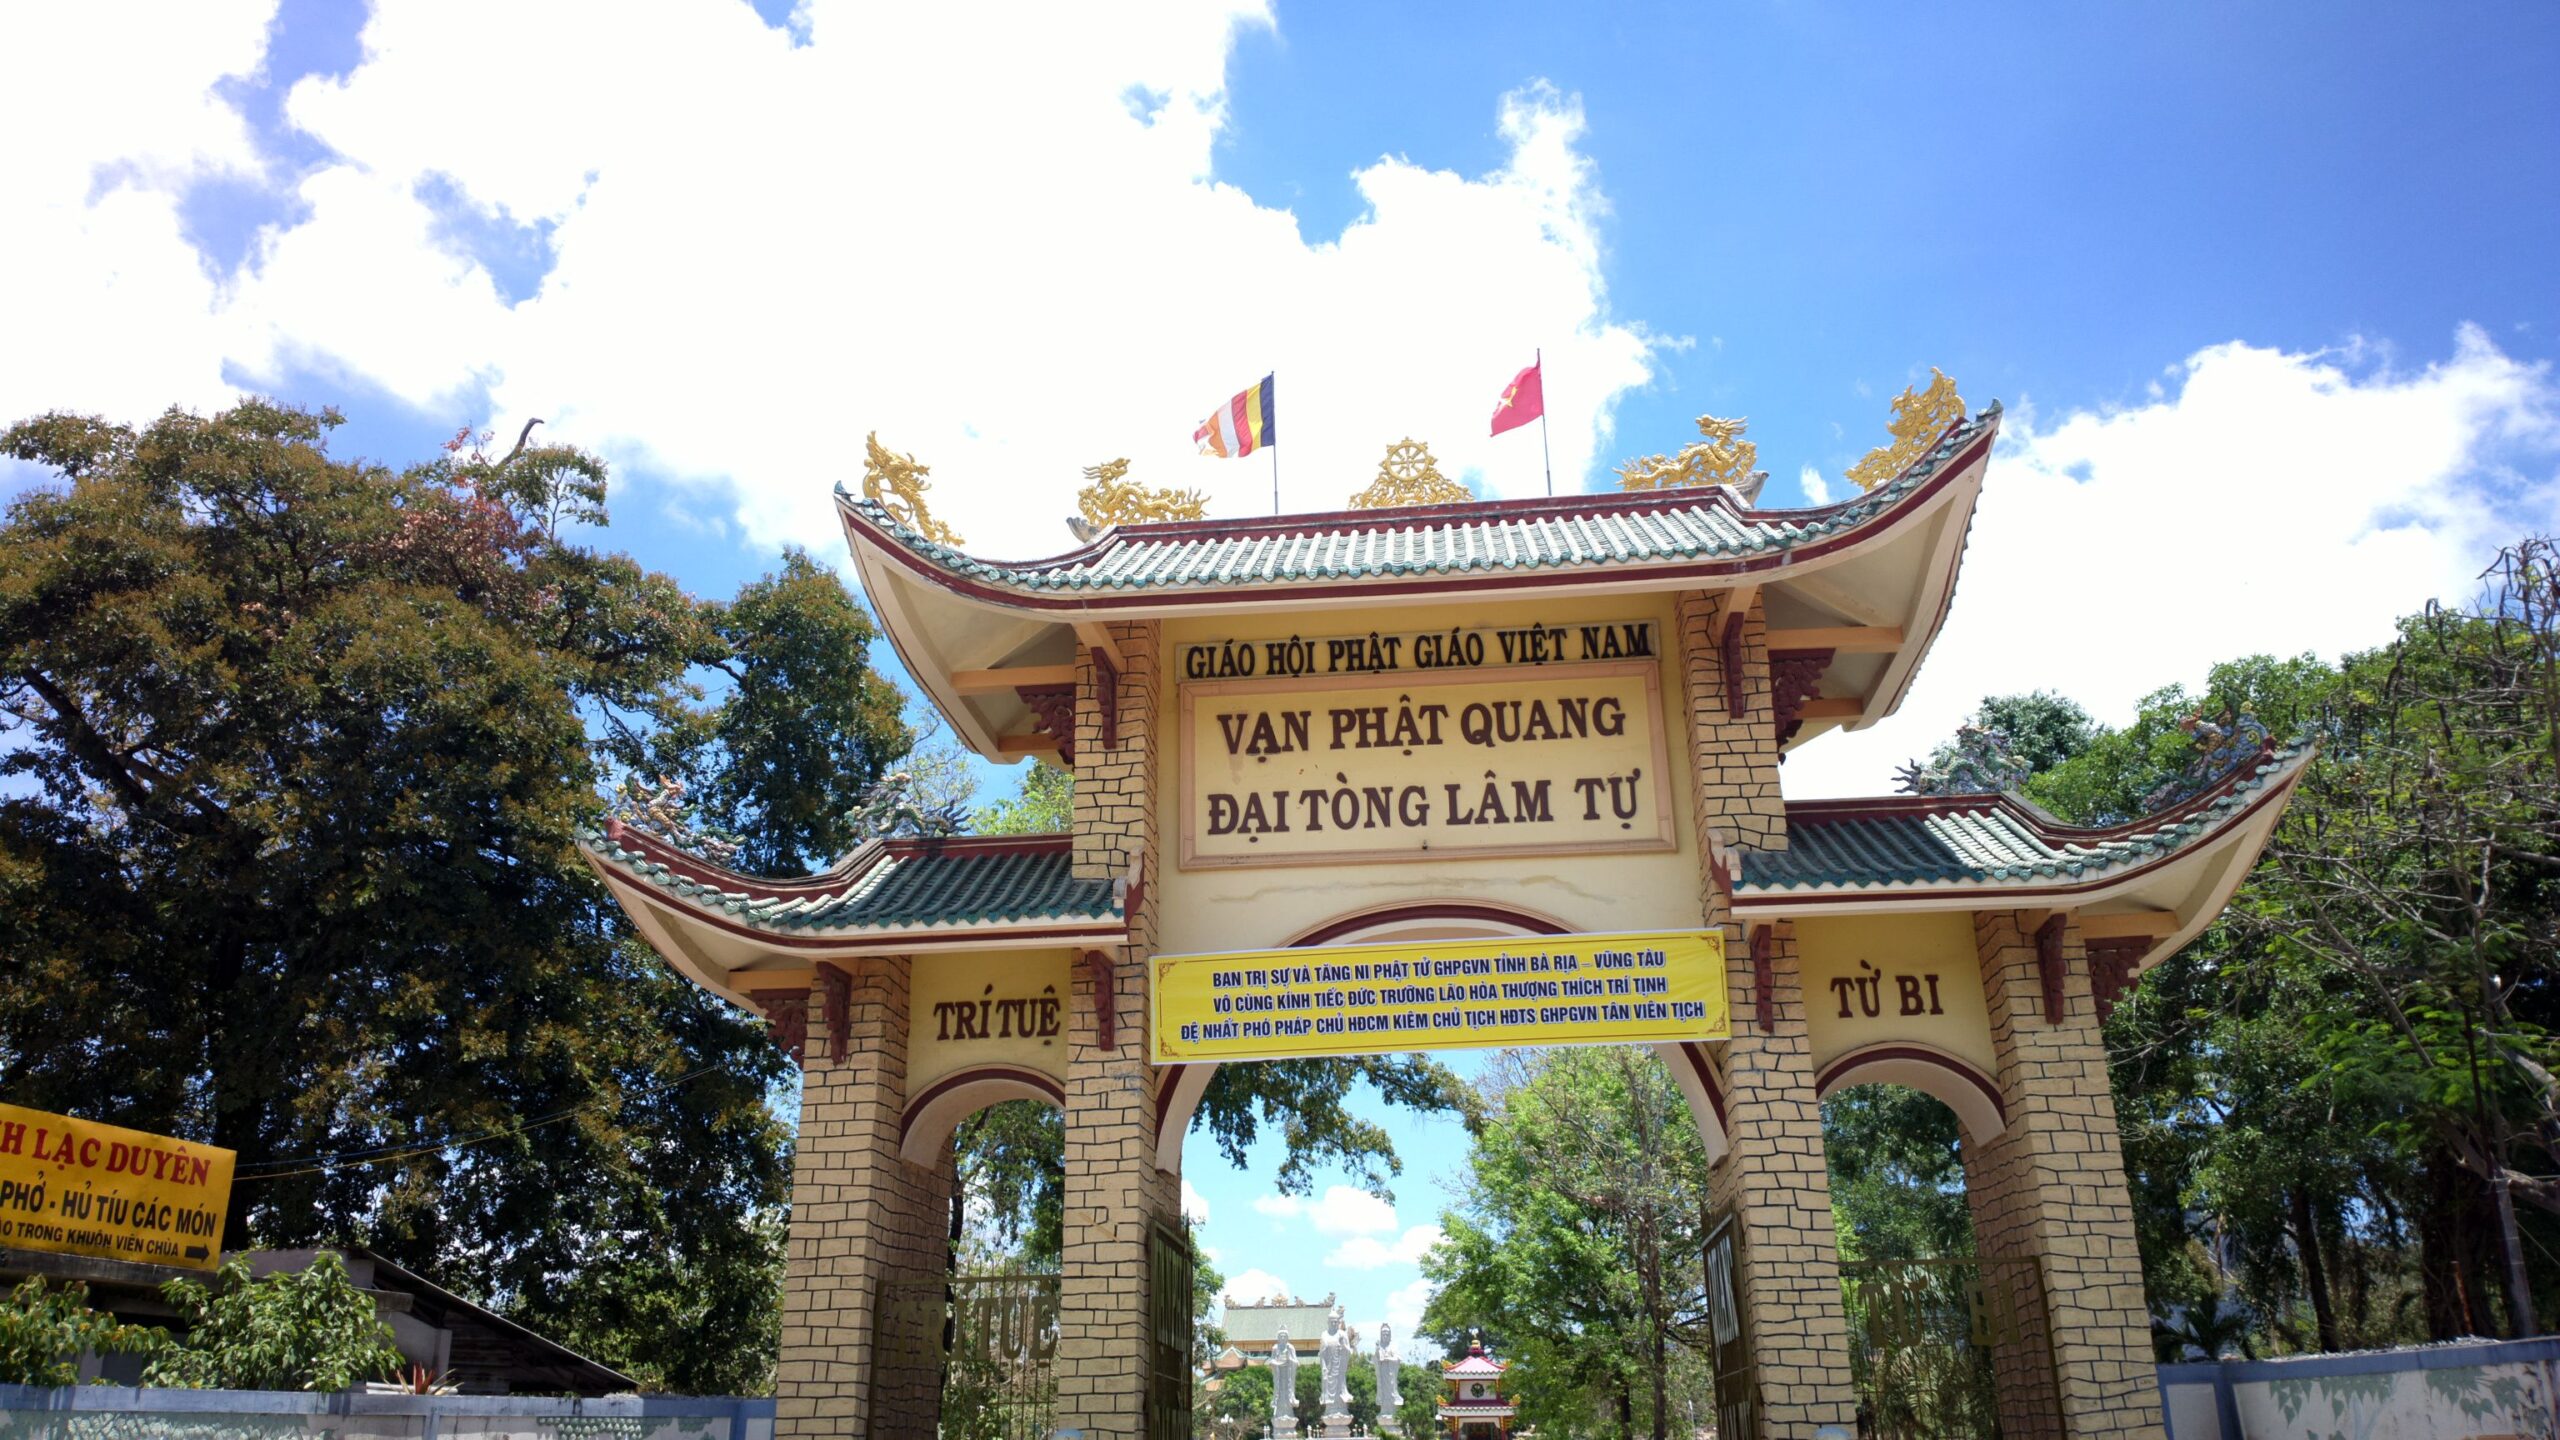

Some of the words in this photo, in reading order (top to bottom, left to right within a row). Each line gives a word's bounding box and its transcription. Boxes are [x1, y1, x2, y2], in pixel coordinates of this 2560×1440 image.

[1186, 638, 1255, 679] GIÁO
[1266, 634, 1315, 678] HỘI
[1327, 631, 1402, 674] PHẬT
[1414, 626, 1484, 669] GIÁO
[1497, 622, 1568, 666] VIỆT
[1580, 623, 1653, 660] NAM
[1216, 711, 1312, 763] VẠN
[1328, 694, 1449, 756] PHẬT
[1460, 697, 1626, 748] QUANG
[1207, 790, 1290, 843] ĐẠI
[1298, 771, 1430, 831] TÒNG
[1444, 769, 1554, 825] LÂM
[1574, 767, 1641, 830] TỰ
[1213, 971, 1241, 987] BAN
[1245, 970, 1266, 988] TRỊ
[1271, 967, 1290, 987] SỰ
[1293, 964, 1310, 983] VÀ
[1314, 963, 1350, 982] TĂNG
[1355, 964, 1370, 980] NI
[1374, 960, 1408, 981] PHẬT
[1413, 957, 1430, 977] TỬ
[1434, 958, 1490, 976] GHPGVN
[1494, 953, 1526, 973] TỈNH
[1530, 952, 1549, 971] BÀ
[1554, 954, 1577, 973] RỊA
[1594, 950, 1633, 968] VŨNG
[1636, 948, 1664, 967] TÀU
[1213, 994, 1231, 1012] VÔ
[1235, 993, 1273, 1012] CÙNG
[1277, 991, 1310, 1009] KÍNH
[1314, 987, 1344, 1007] TIẾC
[1348, 987, 1375, 1006] ĐỨC
[1439, 983, 1464, 1001] LÃO
[1470, 981, 1497, 999] HÒA
[1502, 981, 1557, 1001] THƯỢNG
[1561, 976, 1603, 996] THÍCH
[1607, 975, 1629, 994] TRÍ
[1633, 977, 1666, 996] TỊNH
[1830, 959, 1881, 1018] TỪ
[1895, 974, 1944, 1016] BI
[933, 983, 993, 1041] TRÍ
[995, 984, 1061, 1046] TUỆ
[1181, 1021, 1198, 1043] ĐỆ
[1203, 1018, 1239, 1039] NHẤT
[1243, 1018, 1271, 1036] PHÓ
[1275, 1016, 1312, 1035] PHÁP
[1316, 1012, 1344, 1033] CHỦ
[1348, 1015, 1388, 1031] HĐCM
[1393, 1011, 1428, 1029] KIÊM
[1433, 1007, 1460, 1027] CHỦ
[1465, 1010, 1496, 1029] TỊCH
[1500, 1008, 1536, 1025] HĐTS
[1540, 1006, 1597, 1023] GHPGVN
[1601, 1002, 1629, 1020] TÂN
[1633, 1000, 1667, 1018] VIÊN
[1671, 1001, 1703, 1021] TỊCH
[0, 1121, 27, 1155] H
[32, 1128, 101, 1170] LẠC
[105, 1142, 211, 1187] DUYÊN
[0, 1170, 46, 1213] PHỞ
[61, 1180, 92, 1220] HỦ
[97, 1189, 129, 1225] TÍU
[132, 1196, 171, 1231] CÁC
[175, 1203, 216, 1237] MÓN
[17, 1222, 63, 1242] TRONG
[67, 1229, 112, 1248] KHUÔN
[116, 1233, 144, 1253] VIÊN
[146, 1237, 179, 1257] CHÙA
